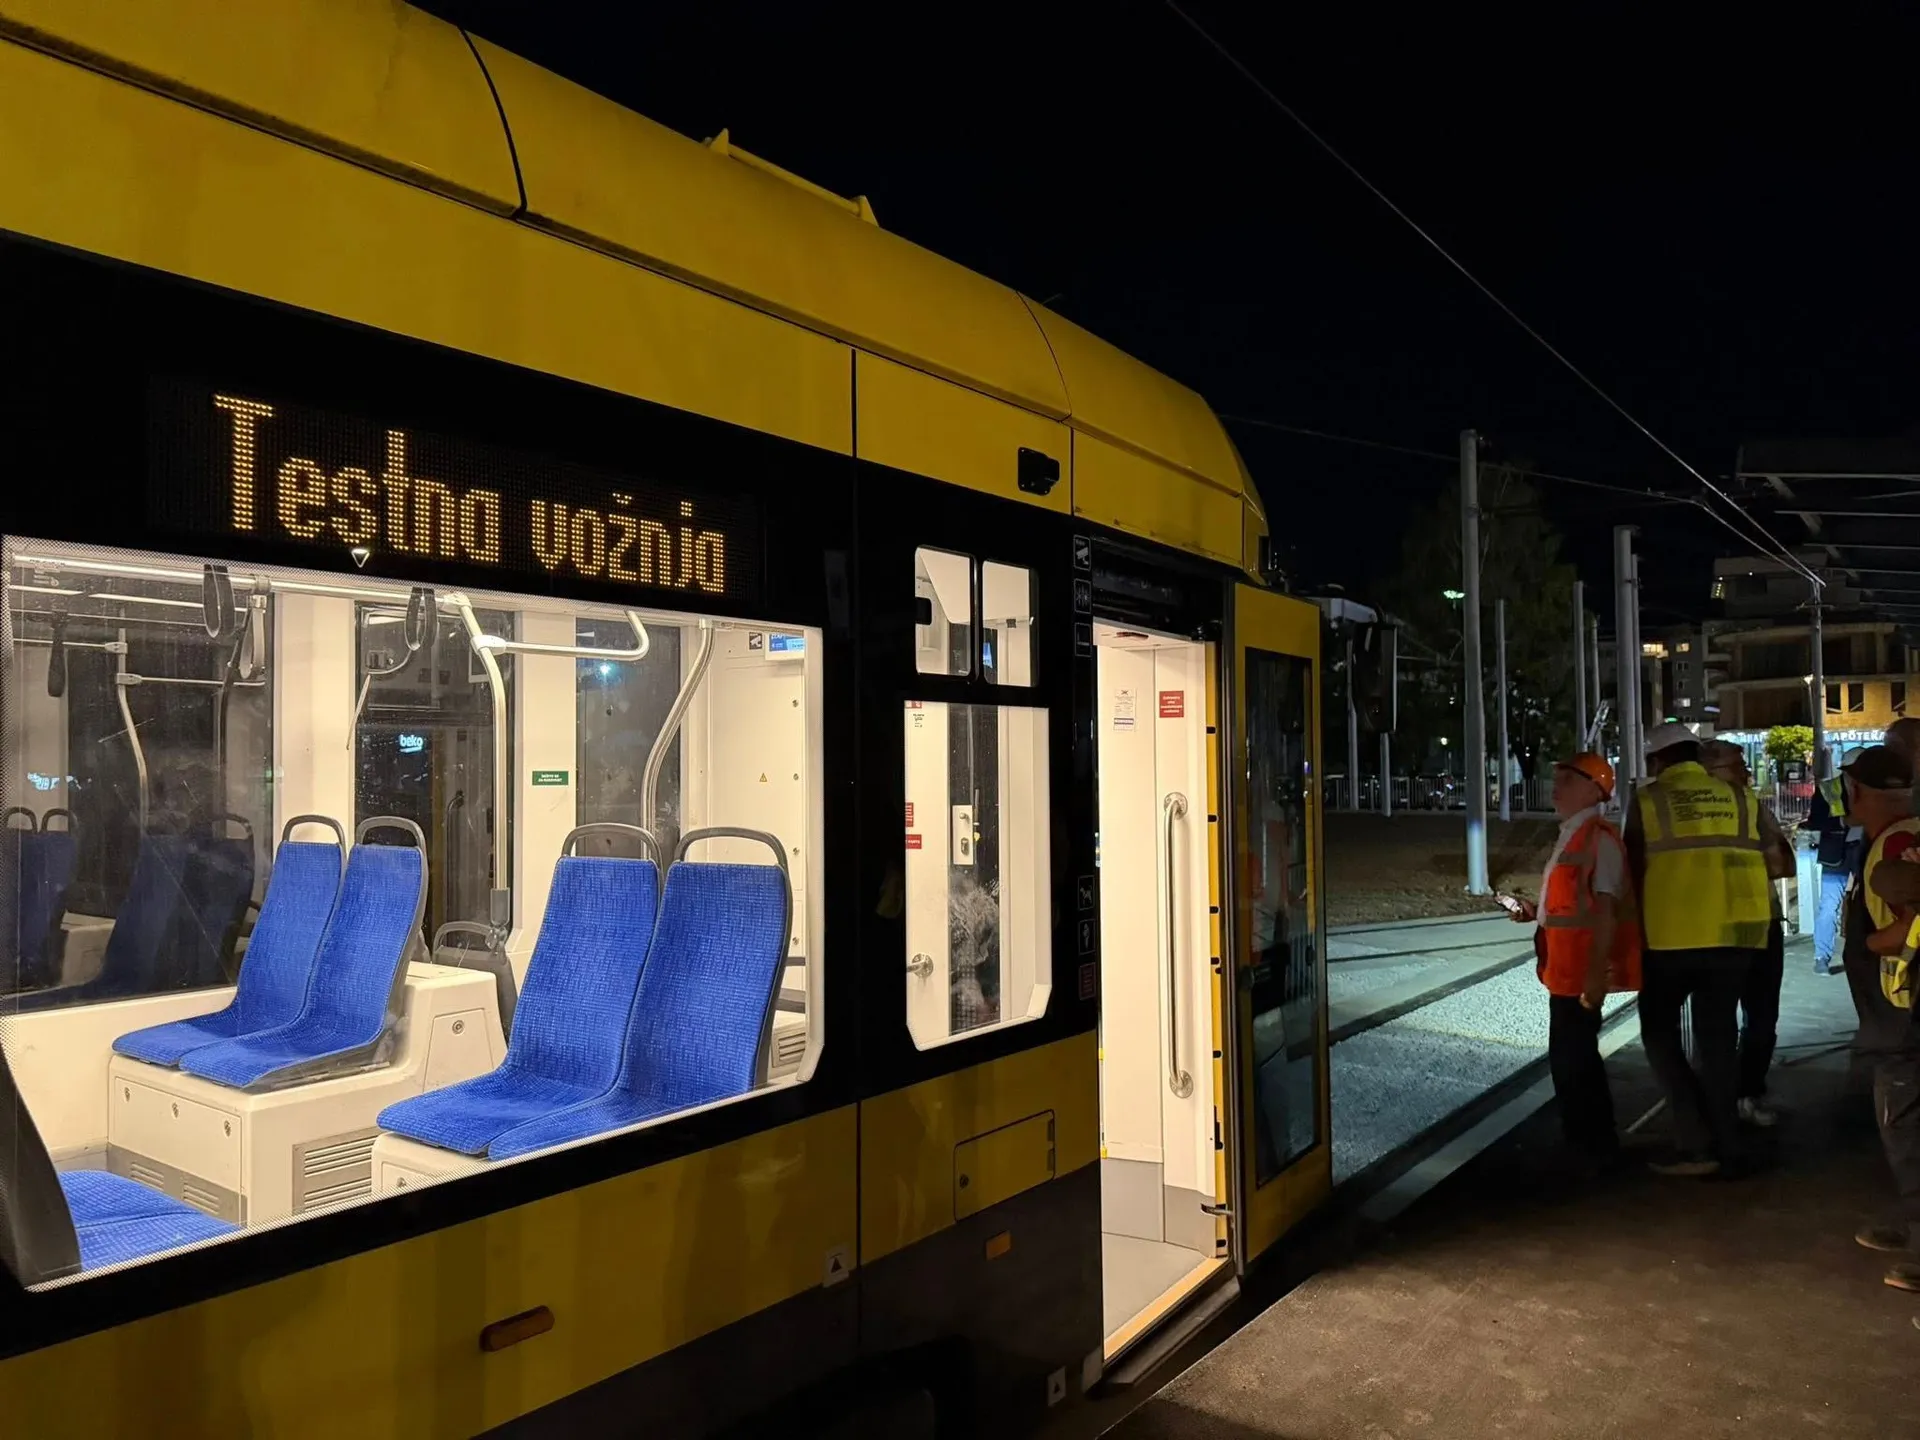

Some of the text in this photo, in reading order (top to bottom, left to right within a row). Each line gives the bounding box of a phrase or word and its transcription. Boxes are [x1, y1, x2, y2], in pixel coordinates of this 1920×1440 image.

[213, 393, 724, 593] Testna vožnja
[398, 734, 424, 747] beko
